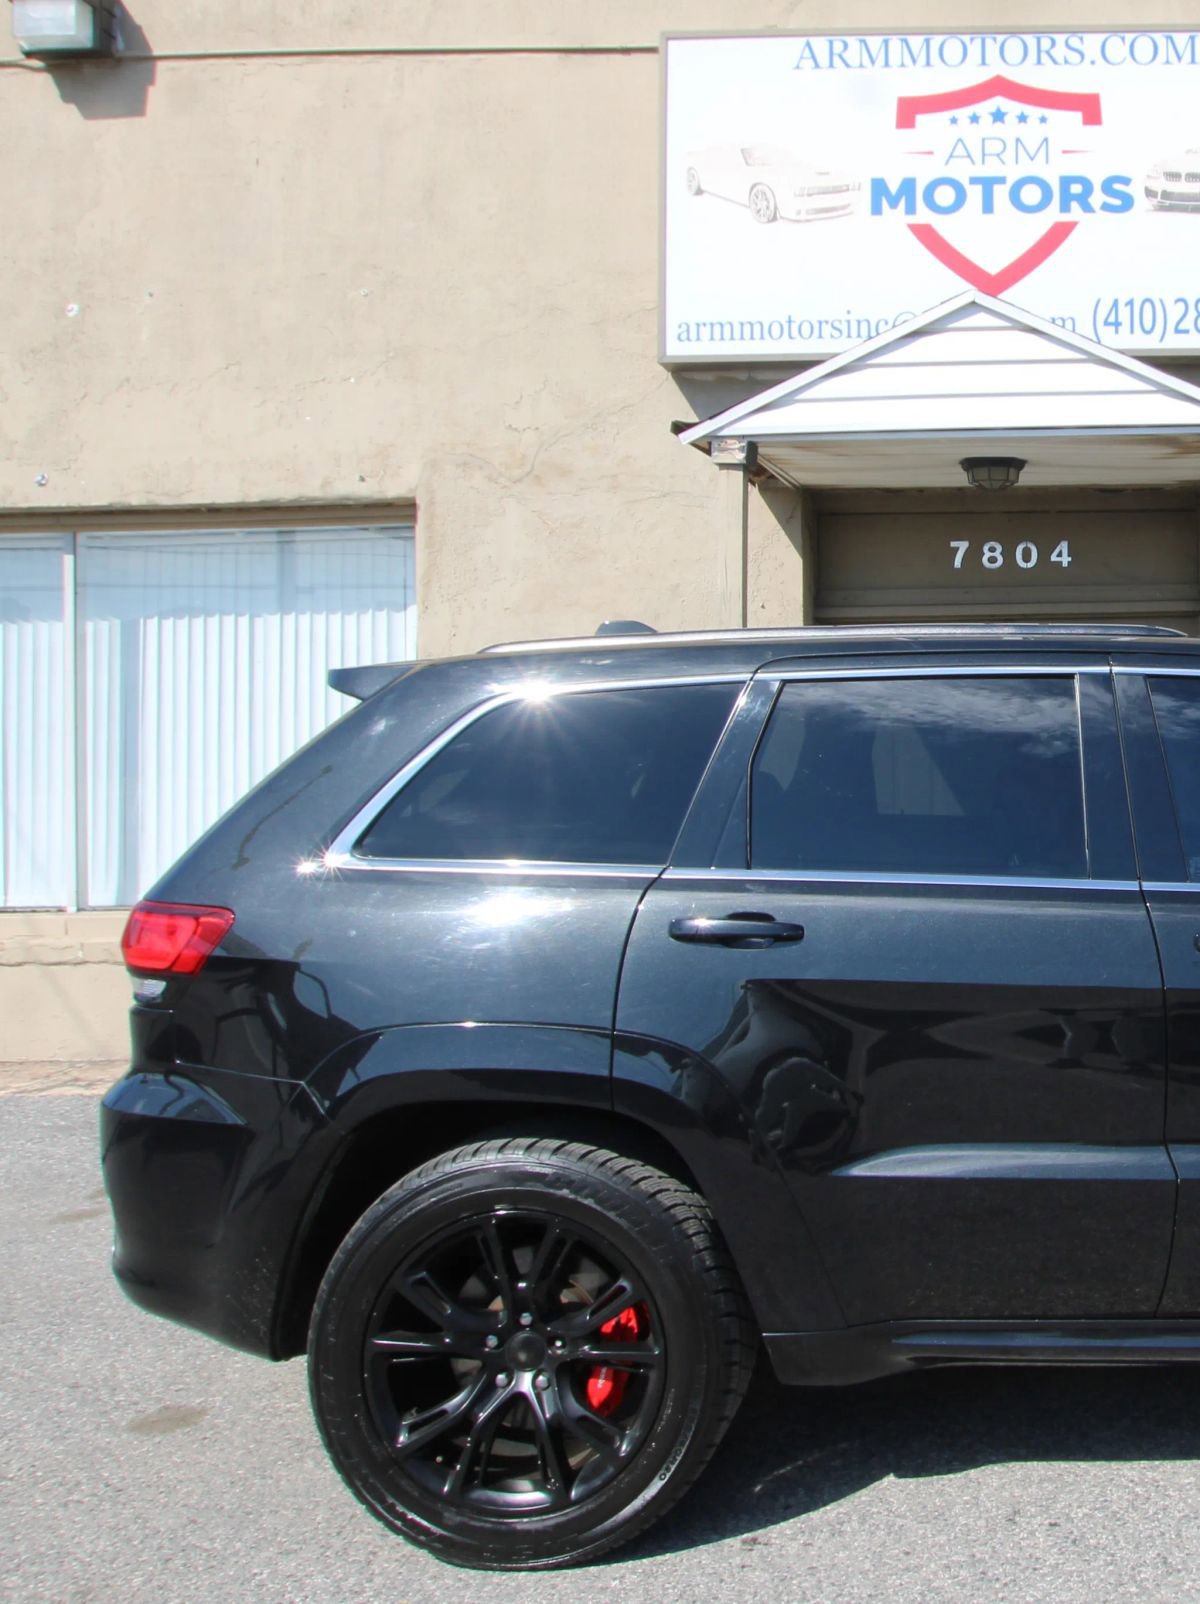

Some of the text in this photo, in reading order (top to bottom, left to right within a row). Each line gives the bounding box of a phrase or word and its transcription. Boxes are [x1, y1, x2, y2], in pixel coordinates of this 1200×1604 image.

[792, 33, 1200, 70] ARMMOTORS.COM
[944, 136, 1050, 166] ARM
[869, 174, 1135, 217] MOTORS
[949, 540, 1073, 569] 7804
